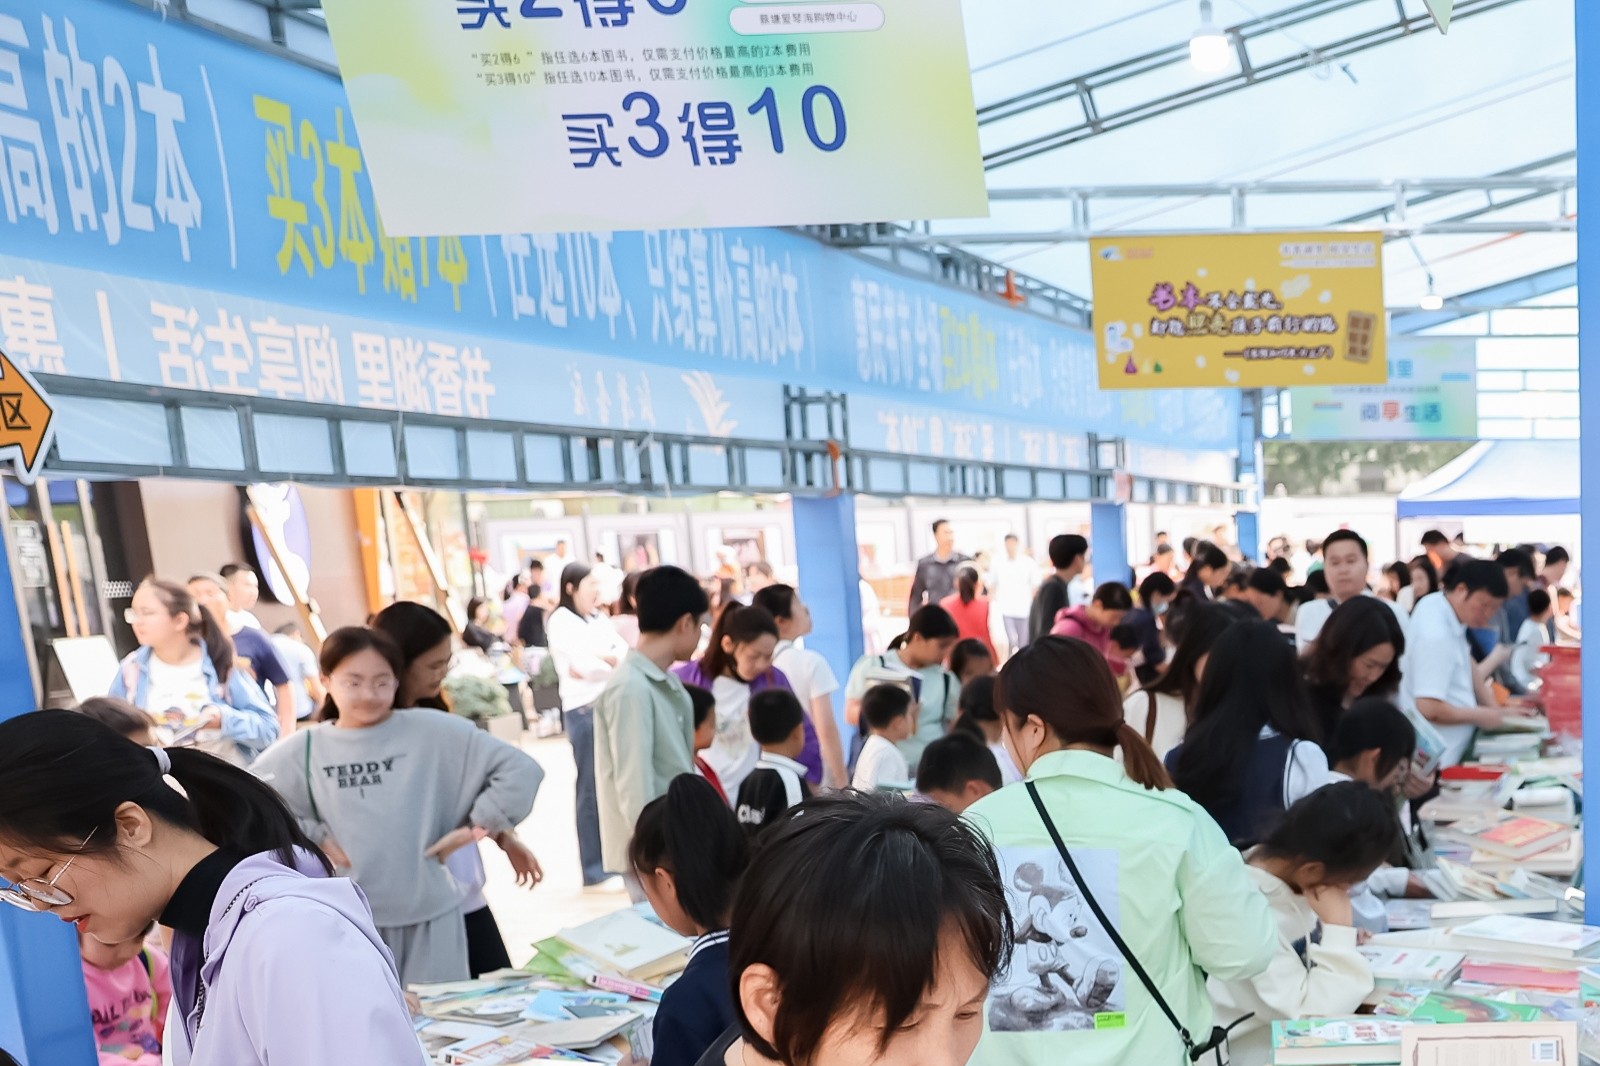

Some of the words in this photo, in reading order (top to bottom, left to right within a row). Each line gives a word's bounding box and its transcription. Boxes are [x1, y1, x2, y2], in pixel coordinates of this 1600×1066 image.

[561, 84, 848, 169] 买3得10
[0, 392, 32, 430] 区
[322, 757, 397, 780] TEDDY
[337, 770, 383, 789] BEAR
